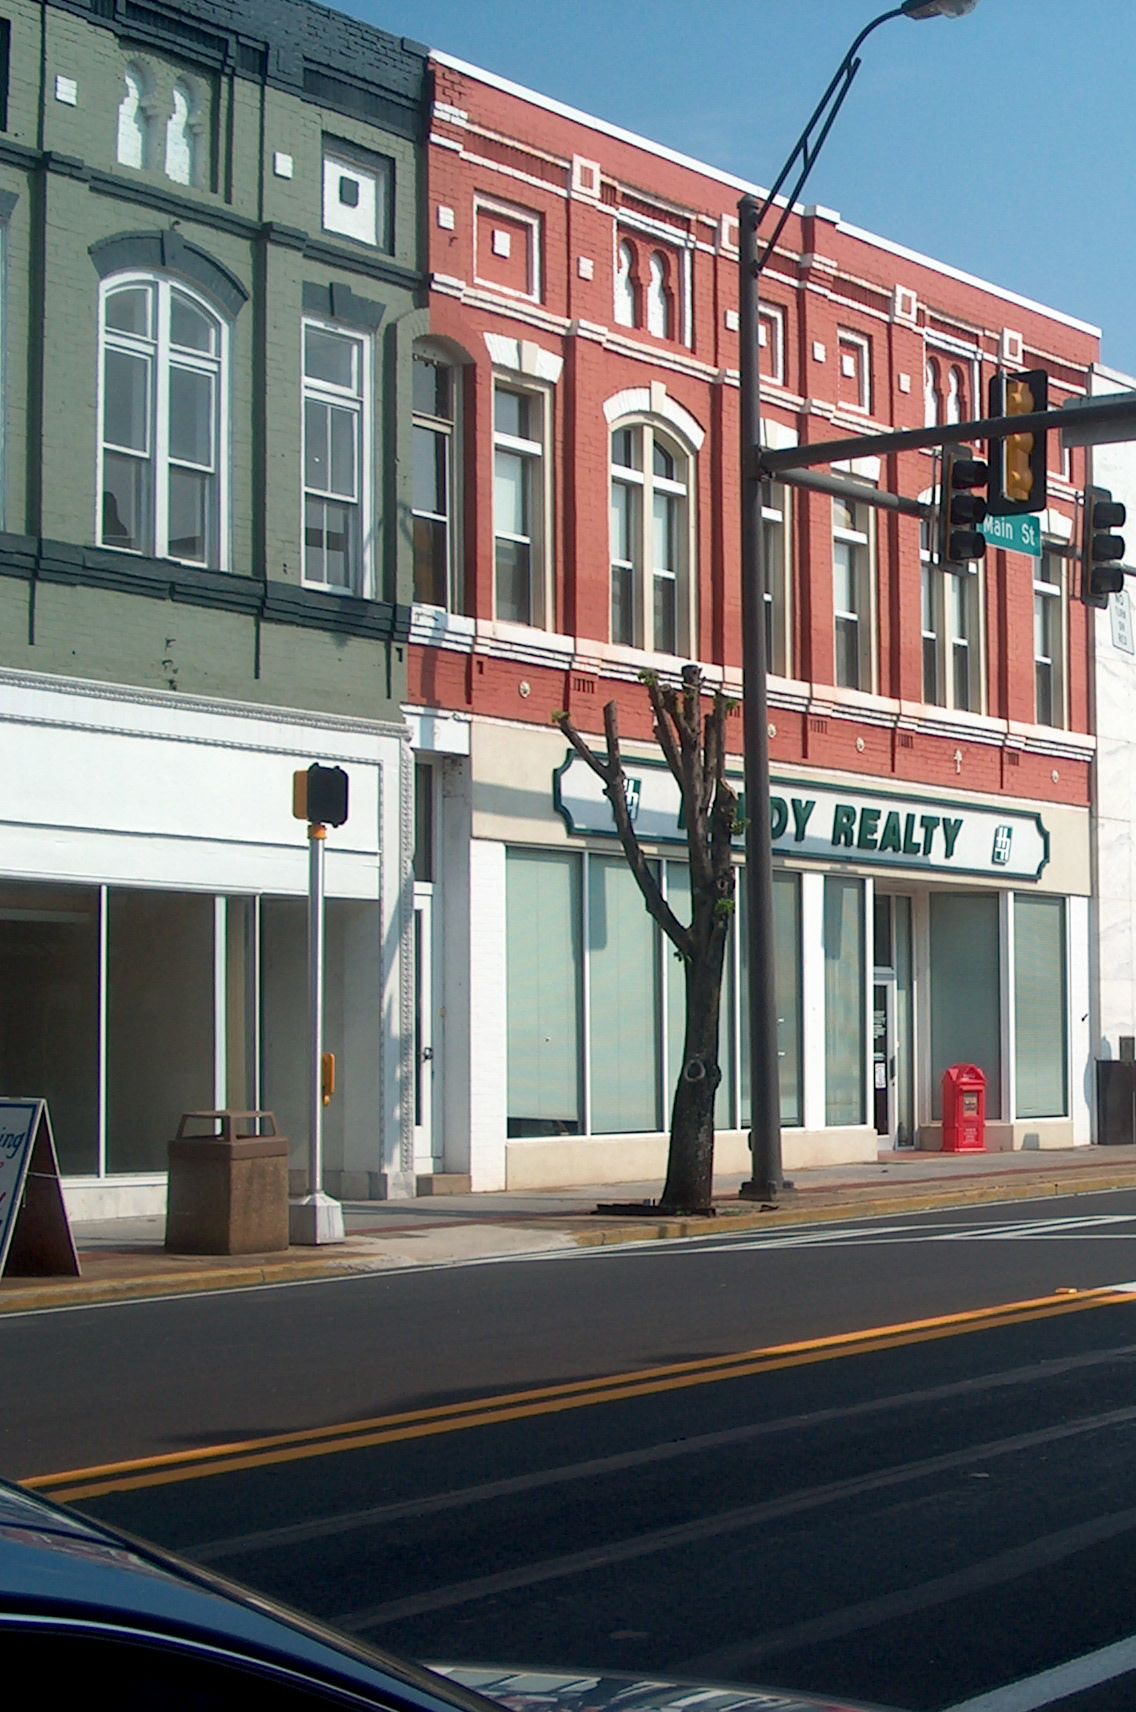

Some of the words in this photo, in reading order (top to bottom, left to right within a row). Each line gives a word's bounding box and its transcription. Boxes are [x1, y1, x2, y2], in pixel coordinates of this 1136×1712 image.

[983, 516, 1013, 540] Main
[1021, 523, 1035, 546] St
[831, 804, 964, 859] REALTY
